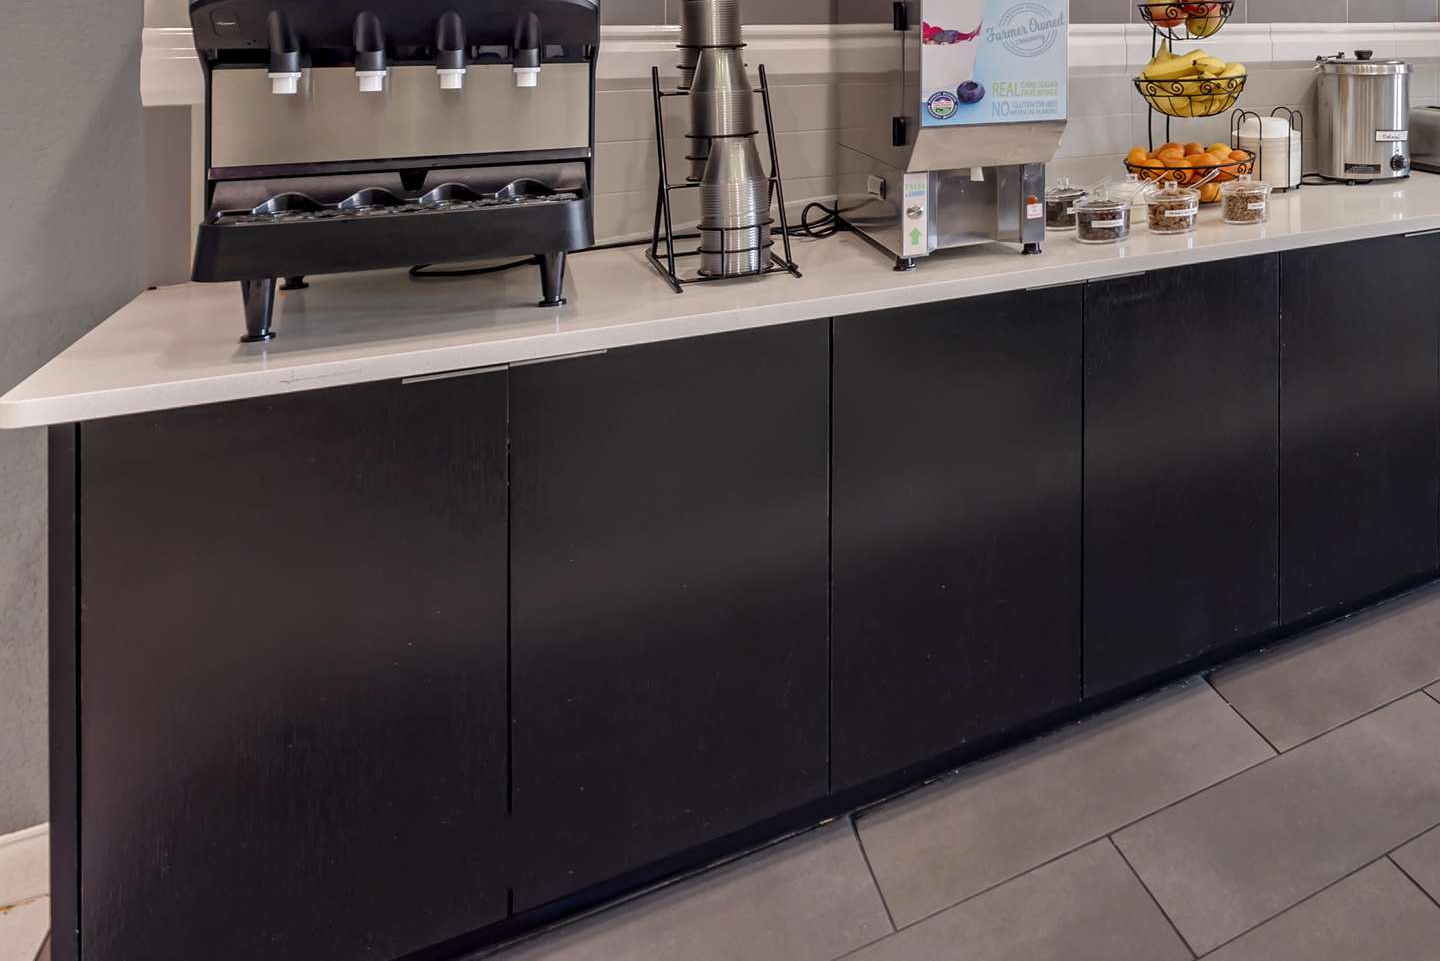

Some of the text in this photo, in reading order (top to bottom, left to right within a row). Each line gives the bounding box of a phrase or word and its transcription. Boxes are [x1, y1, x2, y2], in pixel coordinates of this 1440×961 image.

[986, 26, 1029, 44] Farmer
[1028, 10, 1065, 33] Owned
[992, 81, 1021, 97] REAL
[992, 101, 1010, 117] NO
